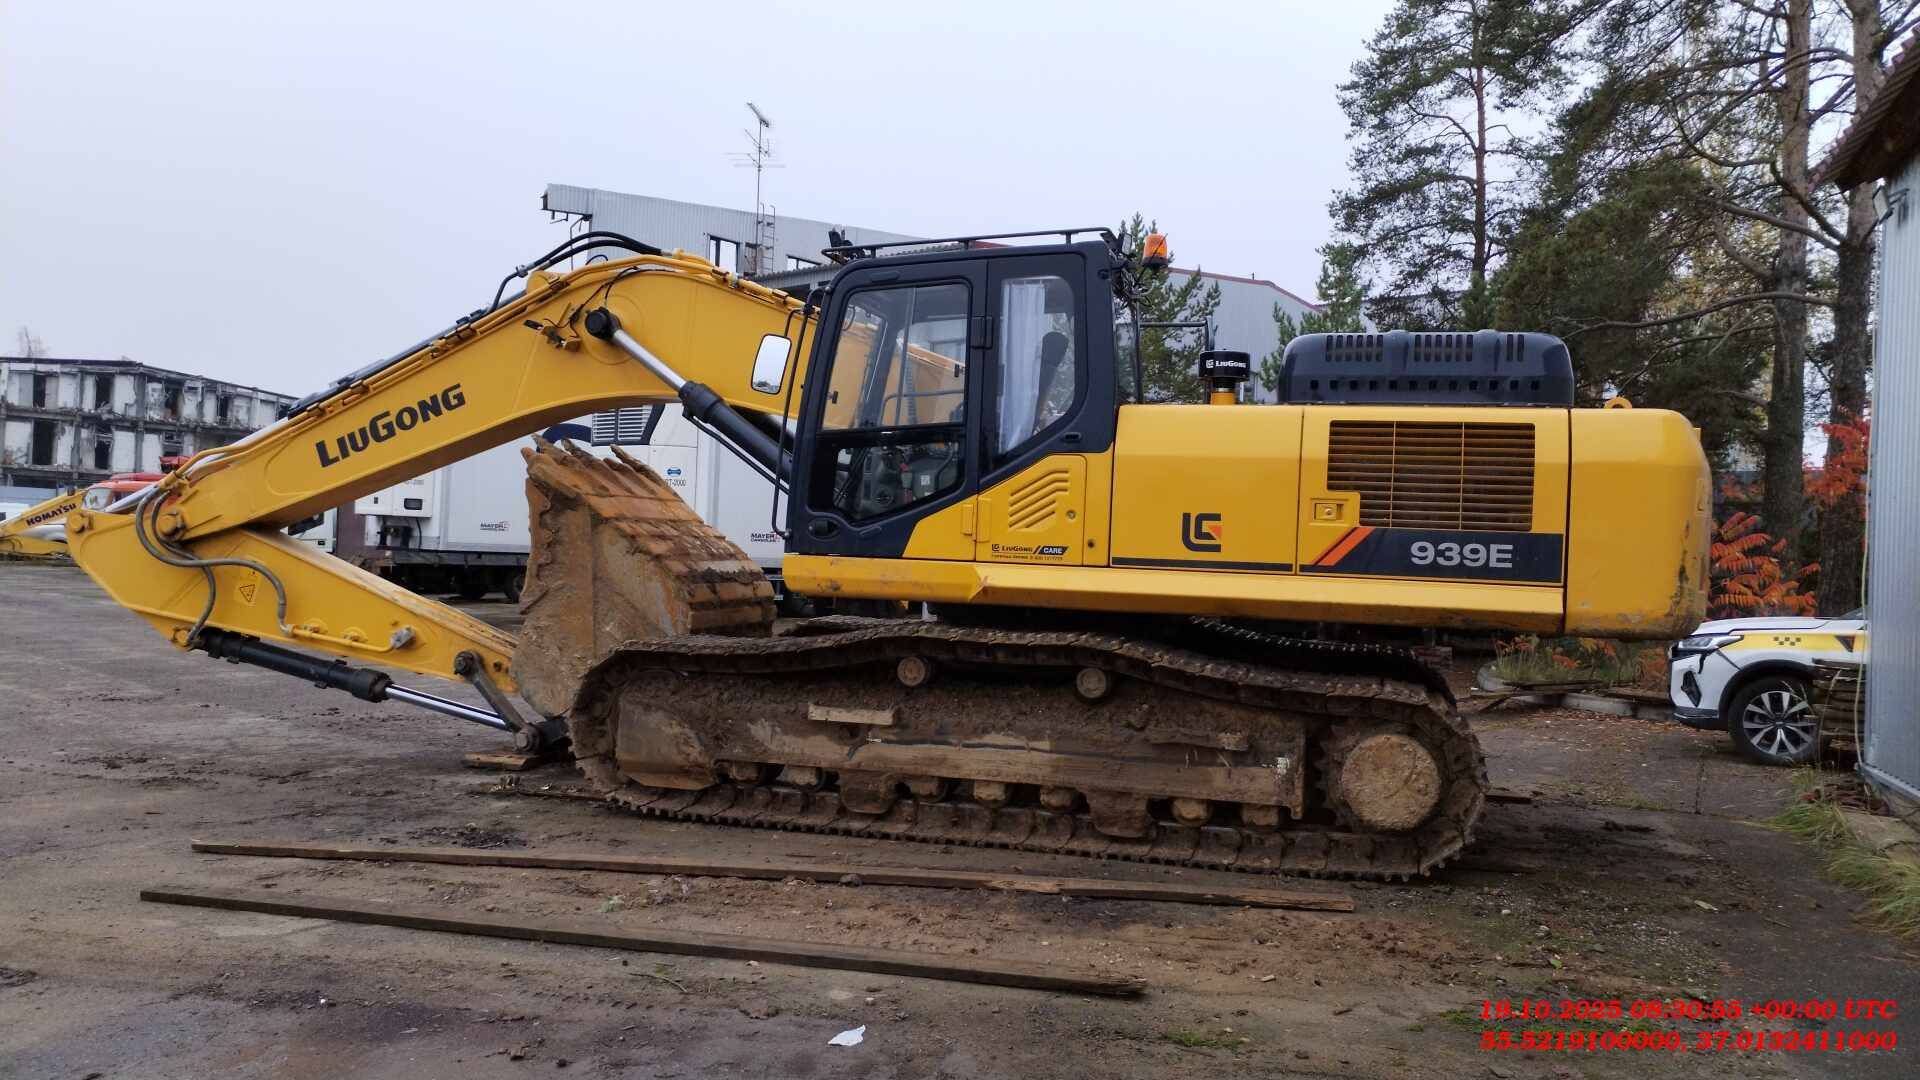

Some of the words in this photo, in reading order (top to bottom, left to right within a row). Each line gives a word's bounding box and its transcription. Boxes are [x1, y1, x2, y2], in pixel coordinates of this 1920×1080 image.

[315, 383, 466, 468] LIUGONG
[26, 503, 77, 526] KOMATSU
[1410, 541, 1514, 568] 939E
